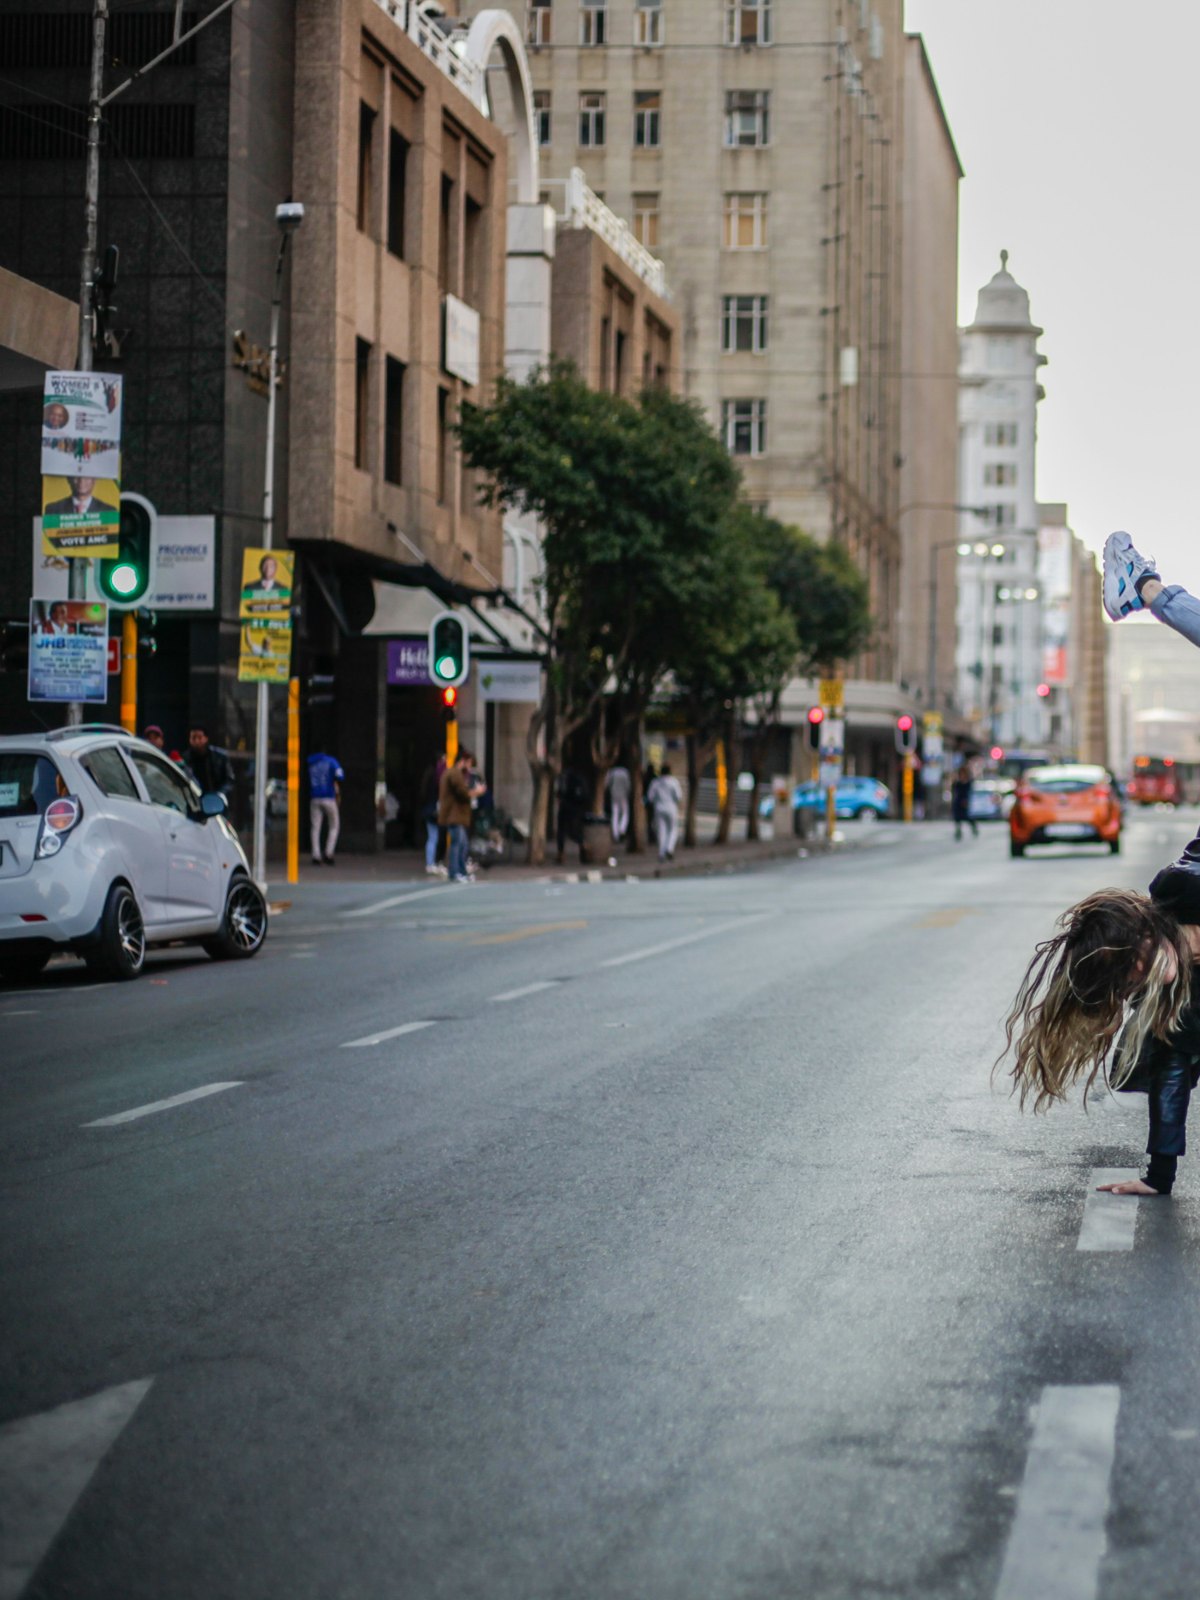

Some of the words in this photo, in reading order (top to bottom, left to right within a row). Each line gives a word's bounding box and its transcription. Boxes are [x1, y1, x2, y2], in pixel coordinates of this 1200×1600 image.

[60, 537, 85, 546] VOTE
[36, 638, 65, 649] JHB
[401, 648, 429, 666] Hell
